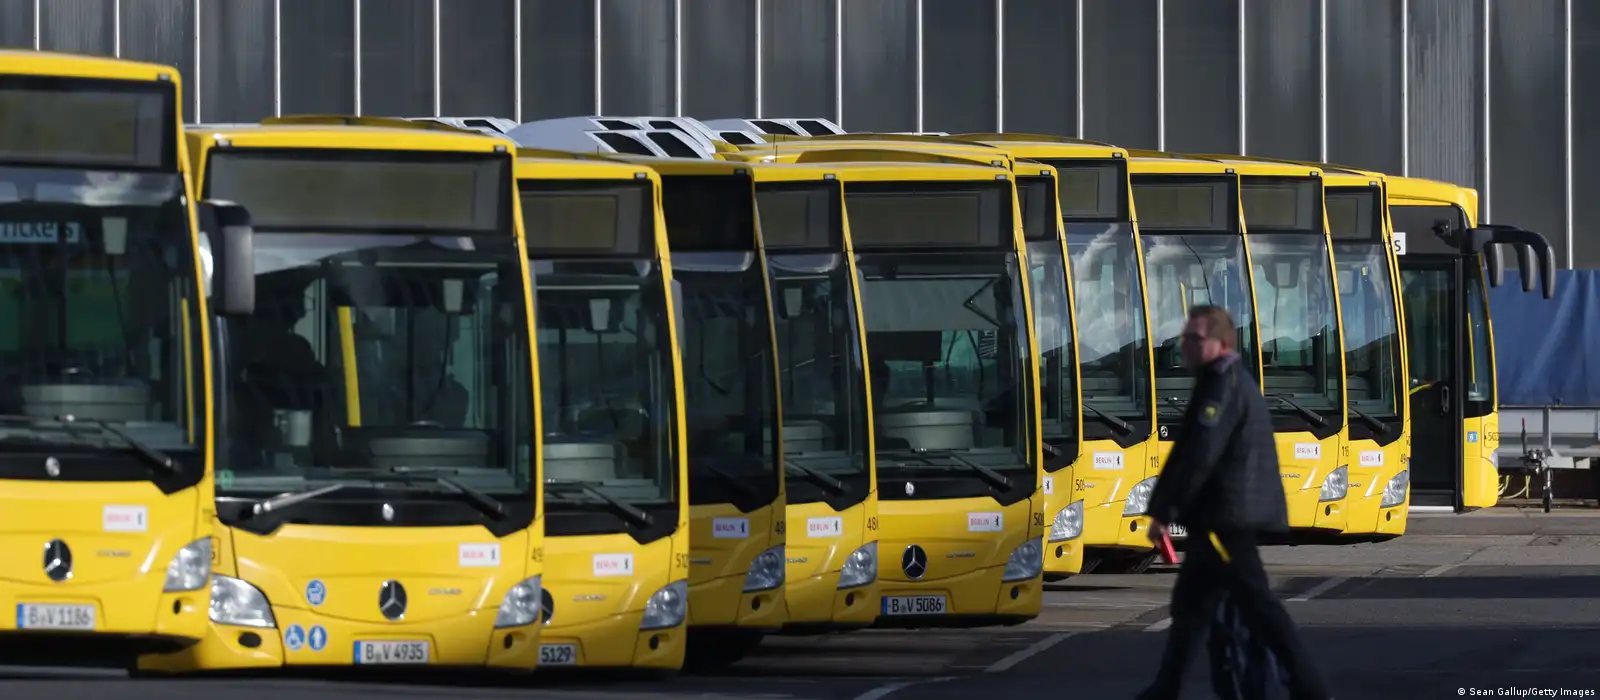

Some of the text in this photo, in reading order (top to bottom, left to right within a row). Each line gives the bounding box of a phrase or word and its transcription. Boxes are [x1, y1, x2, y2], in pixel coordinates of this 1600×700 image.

[1095, 456, 1112, 464] BERLIN
[809, 522, 829, 532] BERLIN
[866, 516, 878, 532] 48
[916, 597, 942, 612] 5086
[394, 643, 424, 660] 4935
[541, 645, 572, 663] 5129
